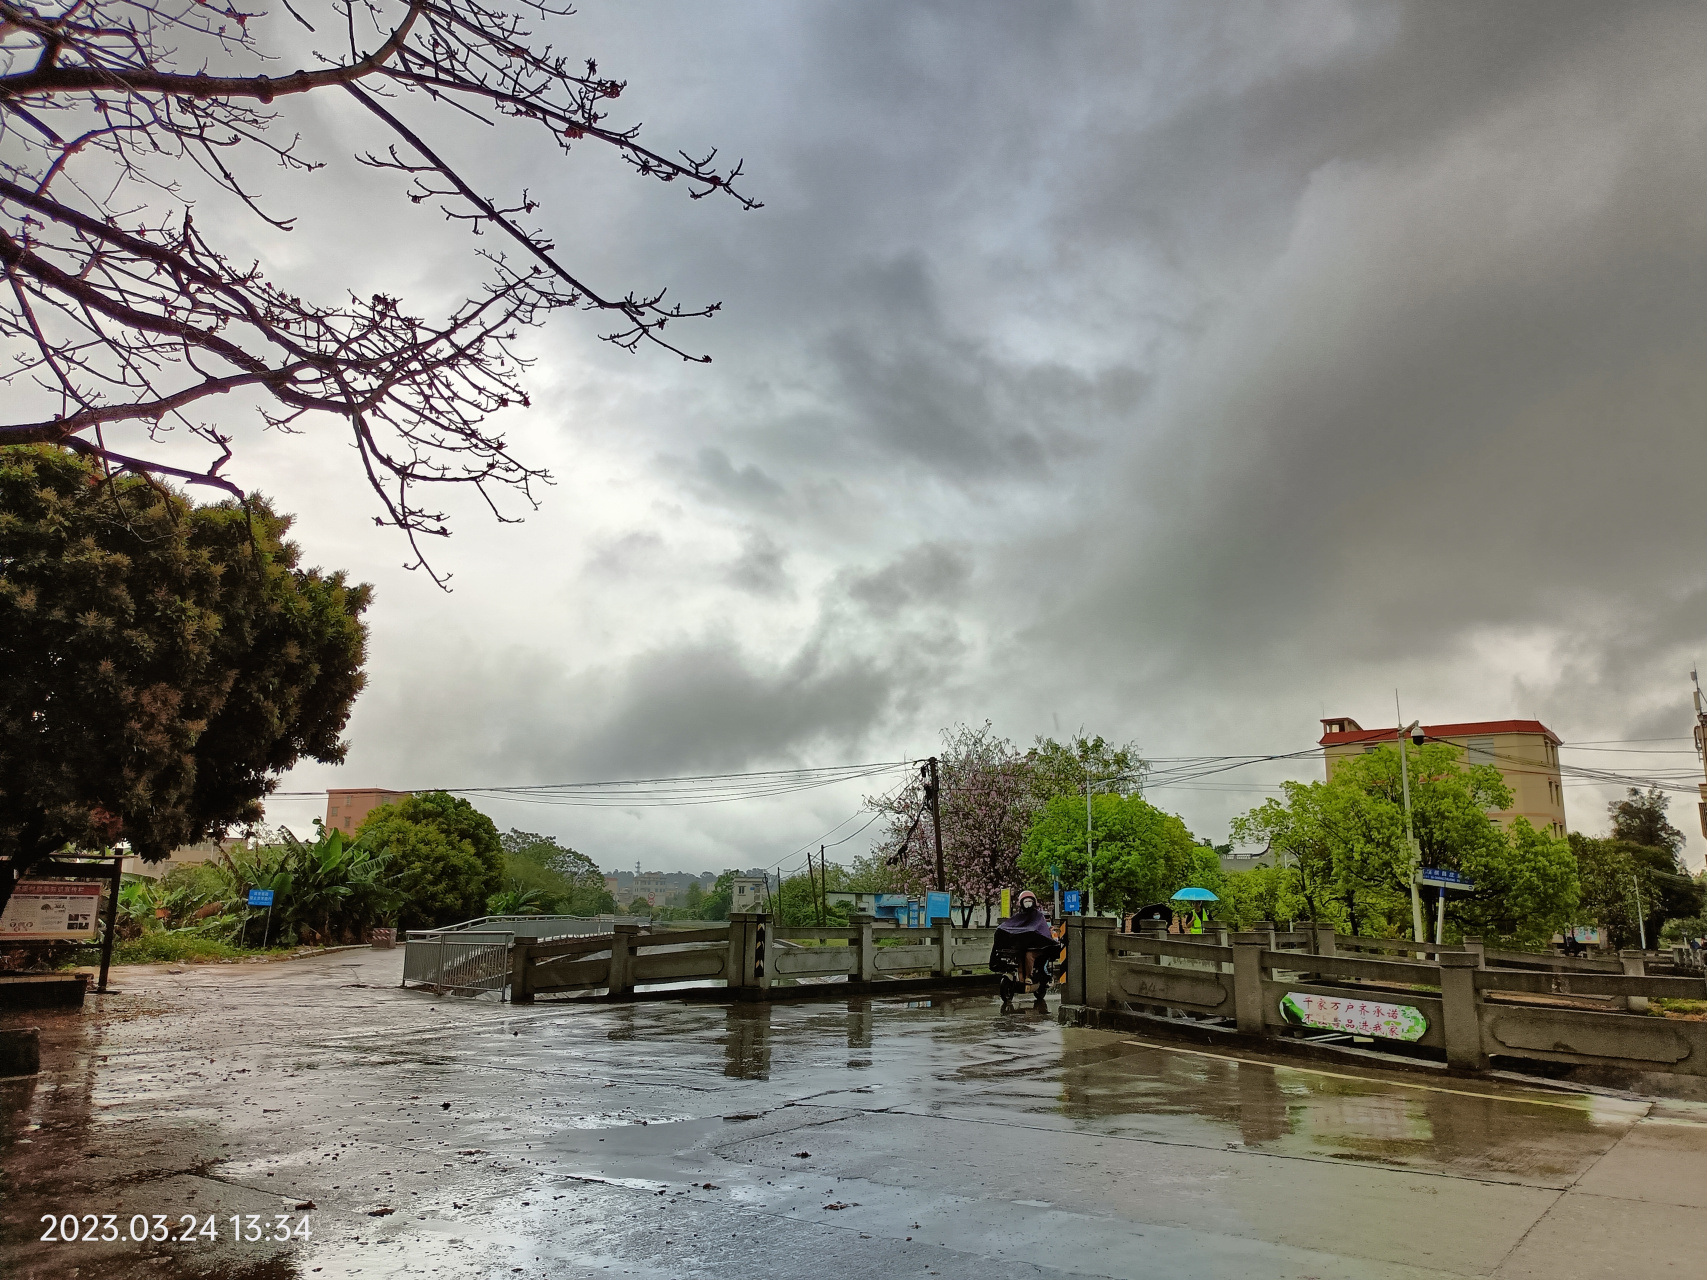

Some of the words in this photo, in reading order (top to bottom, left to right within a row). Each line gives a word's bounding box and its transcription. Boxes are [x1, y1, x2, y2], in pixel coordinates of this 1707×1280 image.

[1303, 996, 1399, 1020] 千家万户齐承诺
